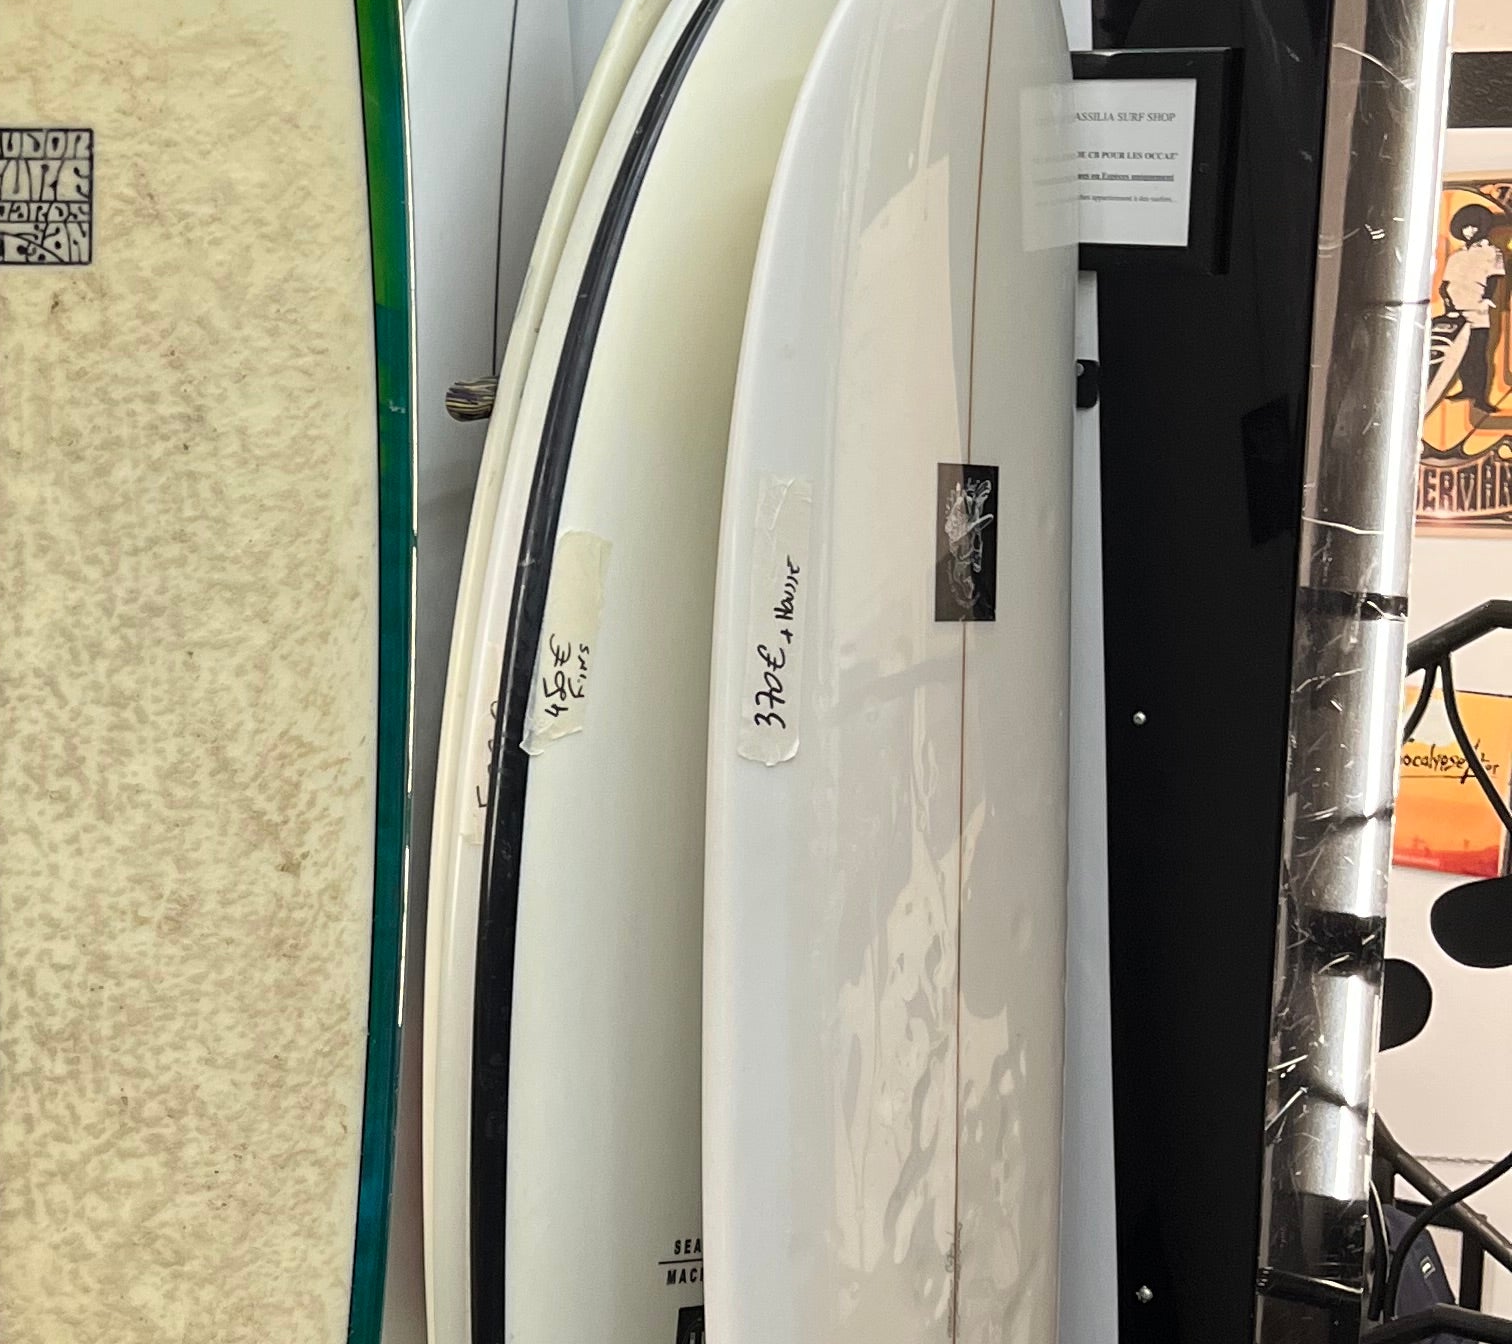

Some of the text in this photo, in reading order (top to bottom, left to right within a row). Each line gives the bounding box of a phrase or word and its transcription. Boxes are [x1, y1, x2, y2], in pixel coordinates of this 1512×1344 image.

[1075, 112, 1115, 123] ASSILIA
[1147, 112, 1176, 122] SHOP
[543, 633, 572, 717] 450€
[754, 643, 787, 730] 370€
[1400, 743, 1466, 772] ocalypse
[673, 1238, 702, 1255] SEA
[666, 1267, 704, 1286] MAC
